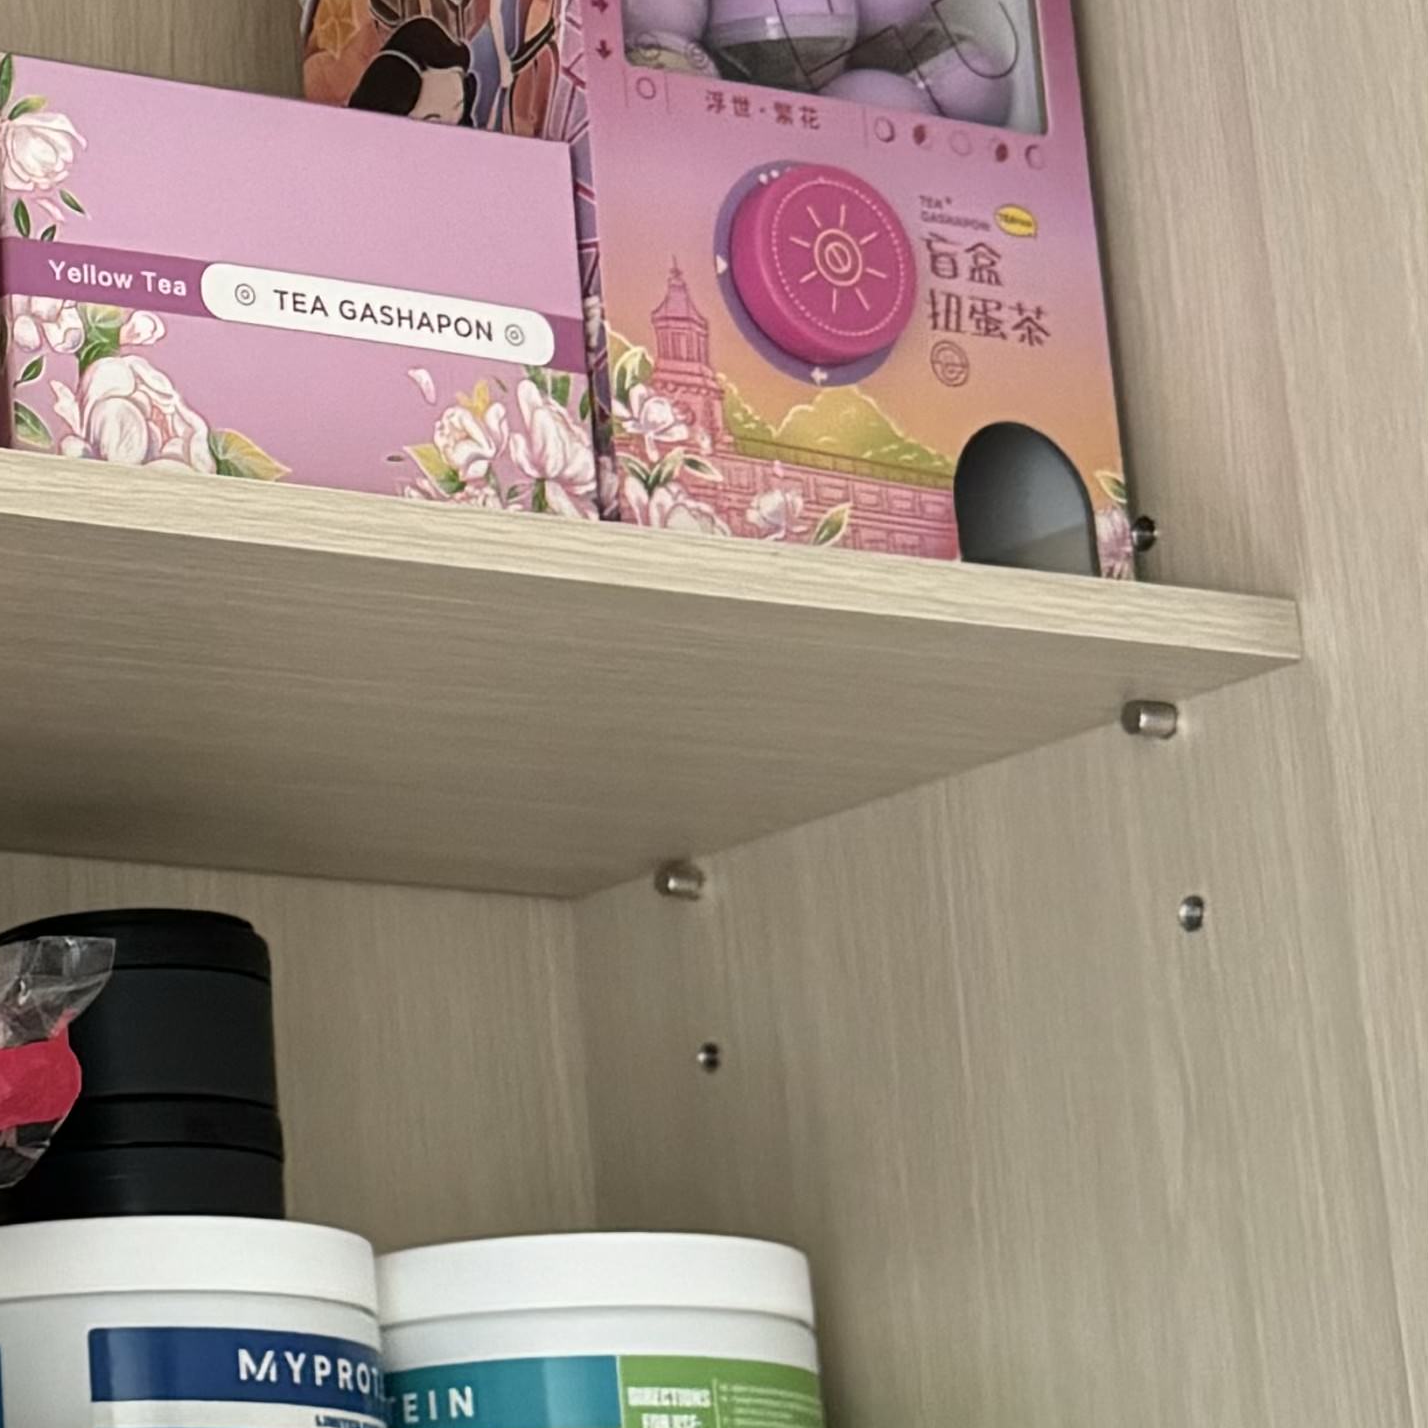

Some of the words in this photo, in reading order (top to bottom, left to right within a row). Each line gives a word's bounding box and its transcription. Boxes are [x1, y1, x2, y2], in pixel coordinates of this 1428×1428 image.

[49, 259, 133, 291] Yellow
[141, 271, 186, 296] Tea
[923, 231, 1002, 286] 盲盒
[274, 290, 328, 317] TEA
[339, 299, 493, 342] GASHAPON
[929, 289, 1051, 347] 扭蛋茶
